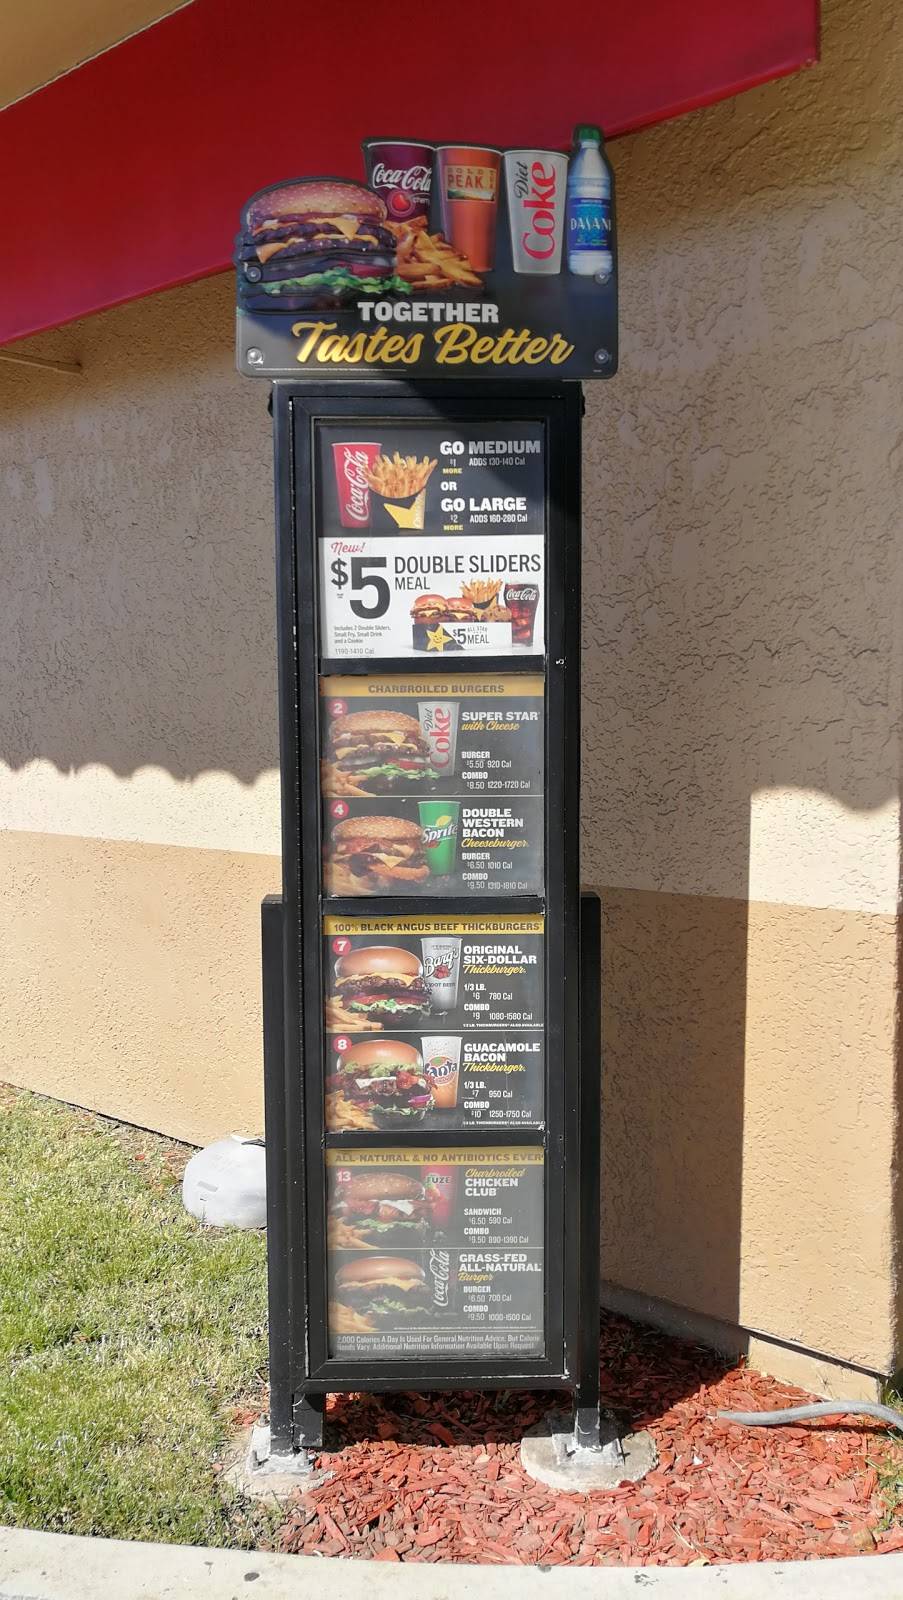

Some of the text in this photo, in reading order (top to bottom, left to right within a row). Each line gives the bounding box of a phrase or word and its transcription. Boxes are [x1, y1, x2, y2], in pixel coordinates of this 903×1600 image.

[372, 162, 432, 192] Coca-Cola
[447, 174, 484, 189] PEAK
[516, 161, 529, 199] Diet
[521, 161, 557, 260] Coke
[570, 217, 612, 231] DASANI
[357, 302, 499, 323] TOGETHER
[292, 321, 575, 366] Tastes Better
[440, 440, 540, 455] GO MEDIUM
[469, 458, 487, 466] ADDS
[514, 457, 526, 466] Cal
[344, 447, 370, 522] Coca-Cola
[440, 481, 457, 491] OR
[441, 498, 465, 512] GO
[469, 497, 526, 512] LARGE
[470, 514, 488, 523] ADDS
[517, 514, 528, 522] Cal
[330, 542, 366, 556] New!
[394, 554, 541, 574] DOUBLE SLIDERS
[330, 556, 390, 619] $5
[394, 576, 430, 590] MEAL
[506, 588, 538, 602] Coca-Cola
[468, 634, 490, 644] MEAL
[368, 684, 504, 694] CHARBROILED BURGERS
[334, 703, 343, 714] 2
[462, 712, 503, 721] SUPER
[461, 720, 520, 731] with Cheese
[430, 706, 452, 768] Coke
[462, 751, 490, 759] BURGER
[488, 760, 500, 768] 920
[462, 772, 488, 780] COMBO
[520, 780, 530, 788] Cal
[334, 804, 344, 815] 4
[462, 808, 512, 818] DOUBLE
[462, 818, 524, 828] WESTERN
[422, 824, 458, 844] Sprite
[462, 828, 504, 838] BACON
[461, 838, 528, 850] Cheeseburger
[462, 872, 488, 880] COMBO
[360, 924, 394, 932] BLACK
[337, 940, 346, 952] 7
[464, 946, 522, 954] ORIGINAL
[464, 955, 537, 964] SIX-DOLLAR
[522, 1012, 532, 1020] Cal
[337, 1039, 347, 1050] 8
[464, 1043, 540, 1052] GUACAMOLE
[464, 1053, 506, 1062] BACON
[464, 1081, 474, 1089] 1/3
[521, 1110, 532, 1118] Cal
[412, 1154, 420, 1162] &
[423, 1154, 438, 1162] NO
[441, 1153, 510, 1162] ANTIBIOTICS
[336, 1170, 351, 1182] 13
[464, 1168, 526, 1178] Charbroiled
[465, 1178, 518, 1187] CHICKEN
[465, 1188, 497, 1196] CLUB
[460, 1254, 528, 1262] GRASS-FED
[430, 1248, 450, 1307] Coca-Cola
[458, 1272, 493, 1283] Burger
[388, 1336, 398, 1344] Day
